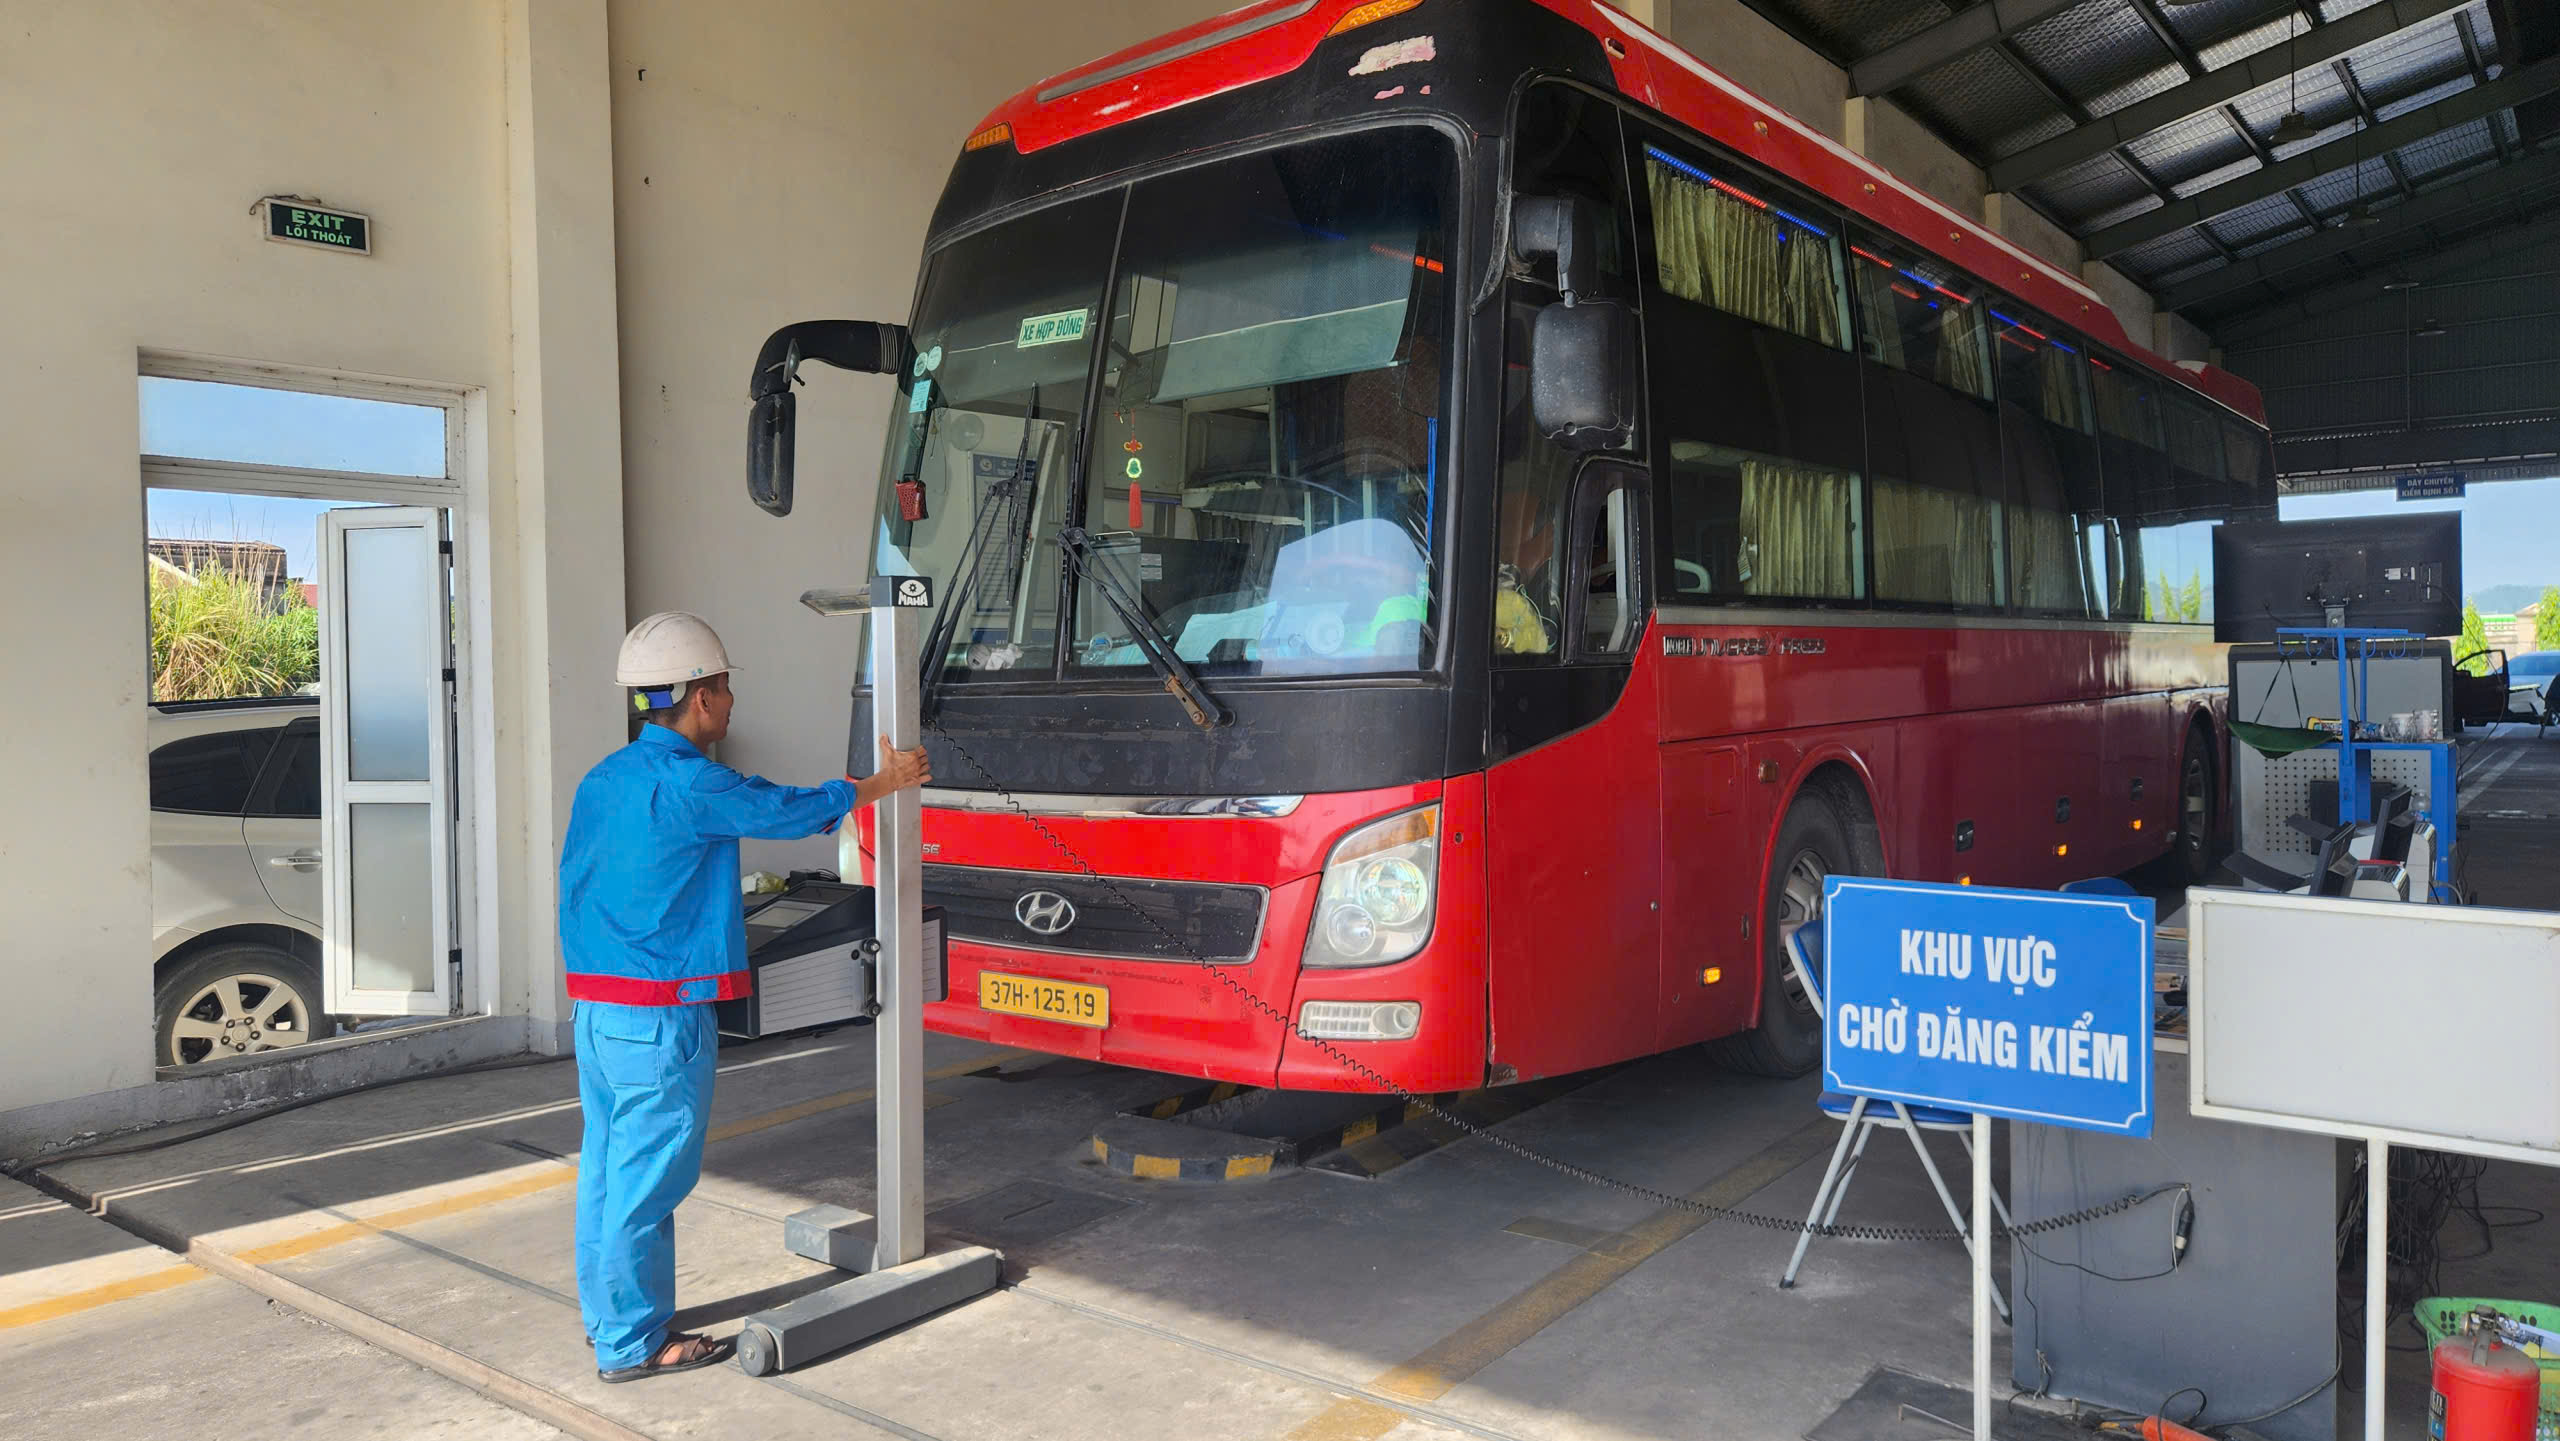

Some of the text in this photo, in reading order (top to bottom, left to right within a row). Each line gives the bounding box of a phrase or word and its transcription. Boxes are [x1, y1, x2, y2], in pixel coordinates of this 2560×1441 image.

[291, 209, 344, 230] EXIT
[286, 223, 352, 246] LỐI THOÁT
[1023, 324, 1035, 341] XE
[1036, 320, 1055, 341] HỢP
[898, 590, 928, 607] MAHA
[1901, 929, 2057, 996] KHU VỰC
[1839, 998, 2129, 1083] CHỜ ĐĂNG KIỂM
